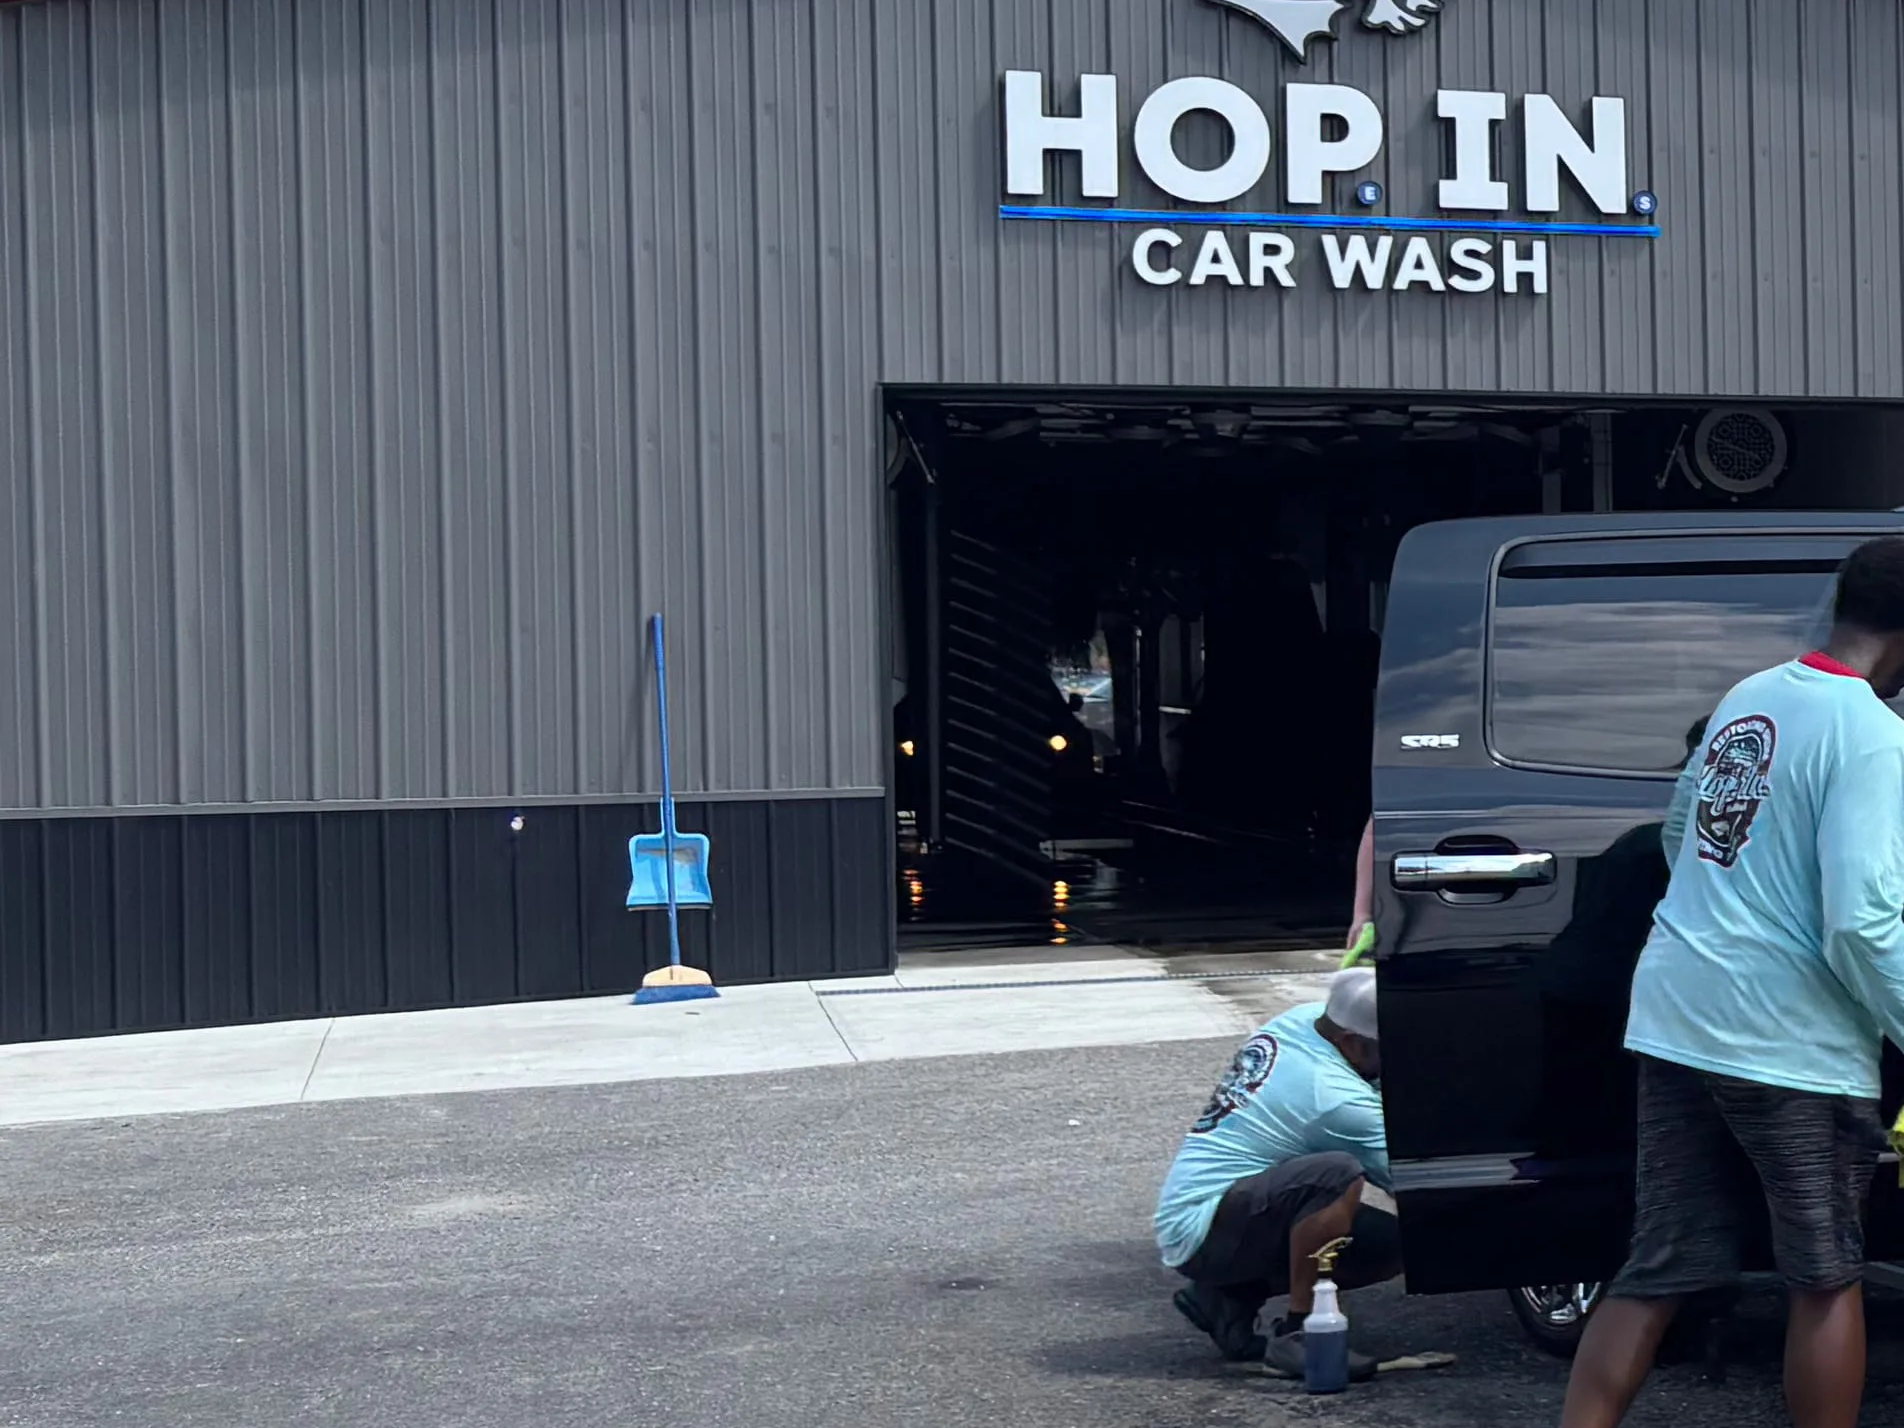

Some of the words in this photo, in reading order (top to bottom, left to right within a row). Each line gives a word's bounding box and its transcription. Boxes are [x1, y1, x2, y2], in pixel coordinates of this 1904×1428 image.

[1004, 69, 1384, 204] HOP
[1437, 88, 1628, 215] IN
[1132, 227, 1298, 287] CAR
[1320, 233, 1549, 294] WASH
